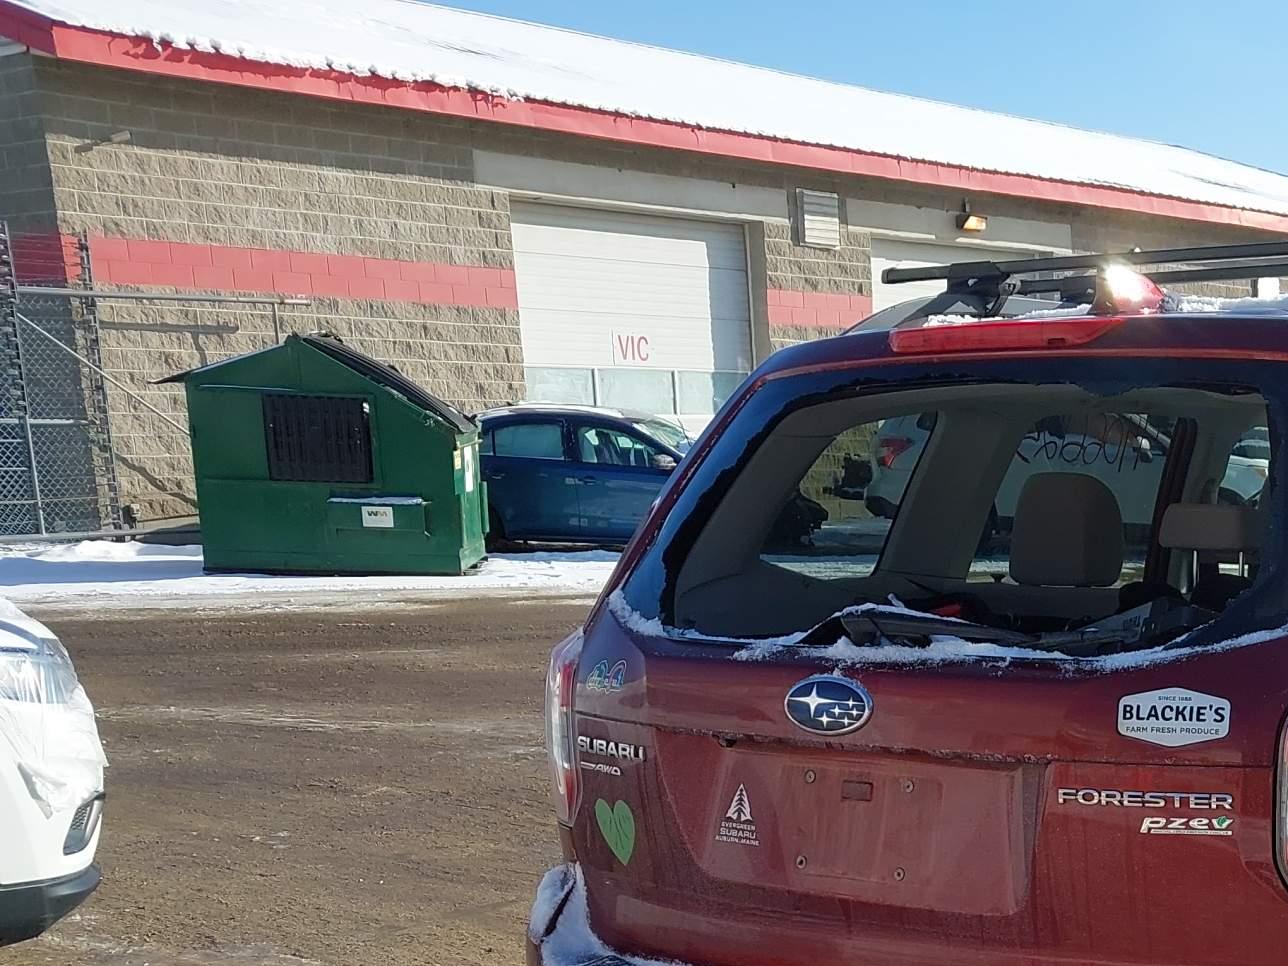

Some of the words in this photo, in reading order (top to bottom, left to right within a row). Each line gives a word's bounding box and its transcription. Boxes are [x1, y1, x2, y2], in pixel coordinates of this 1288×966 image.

[617, 334, 649, 361] VIC
[1122, 704, 1226, 723] BLACKIE'S
[1180, 727, 1220, 736] PRODUCE
[577, 735, 645, 762] SUBARU
[594, 764, 621, 776] AWD
[1058, 788, 1233, 810] FORESTER
[720, 827, 756, 839] SUBARU
